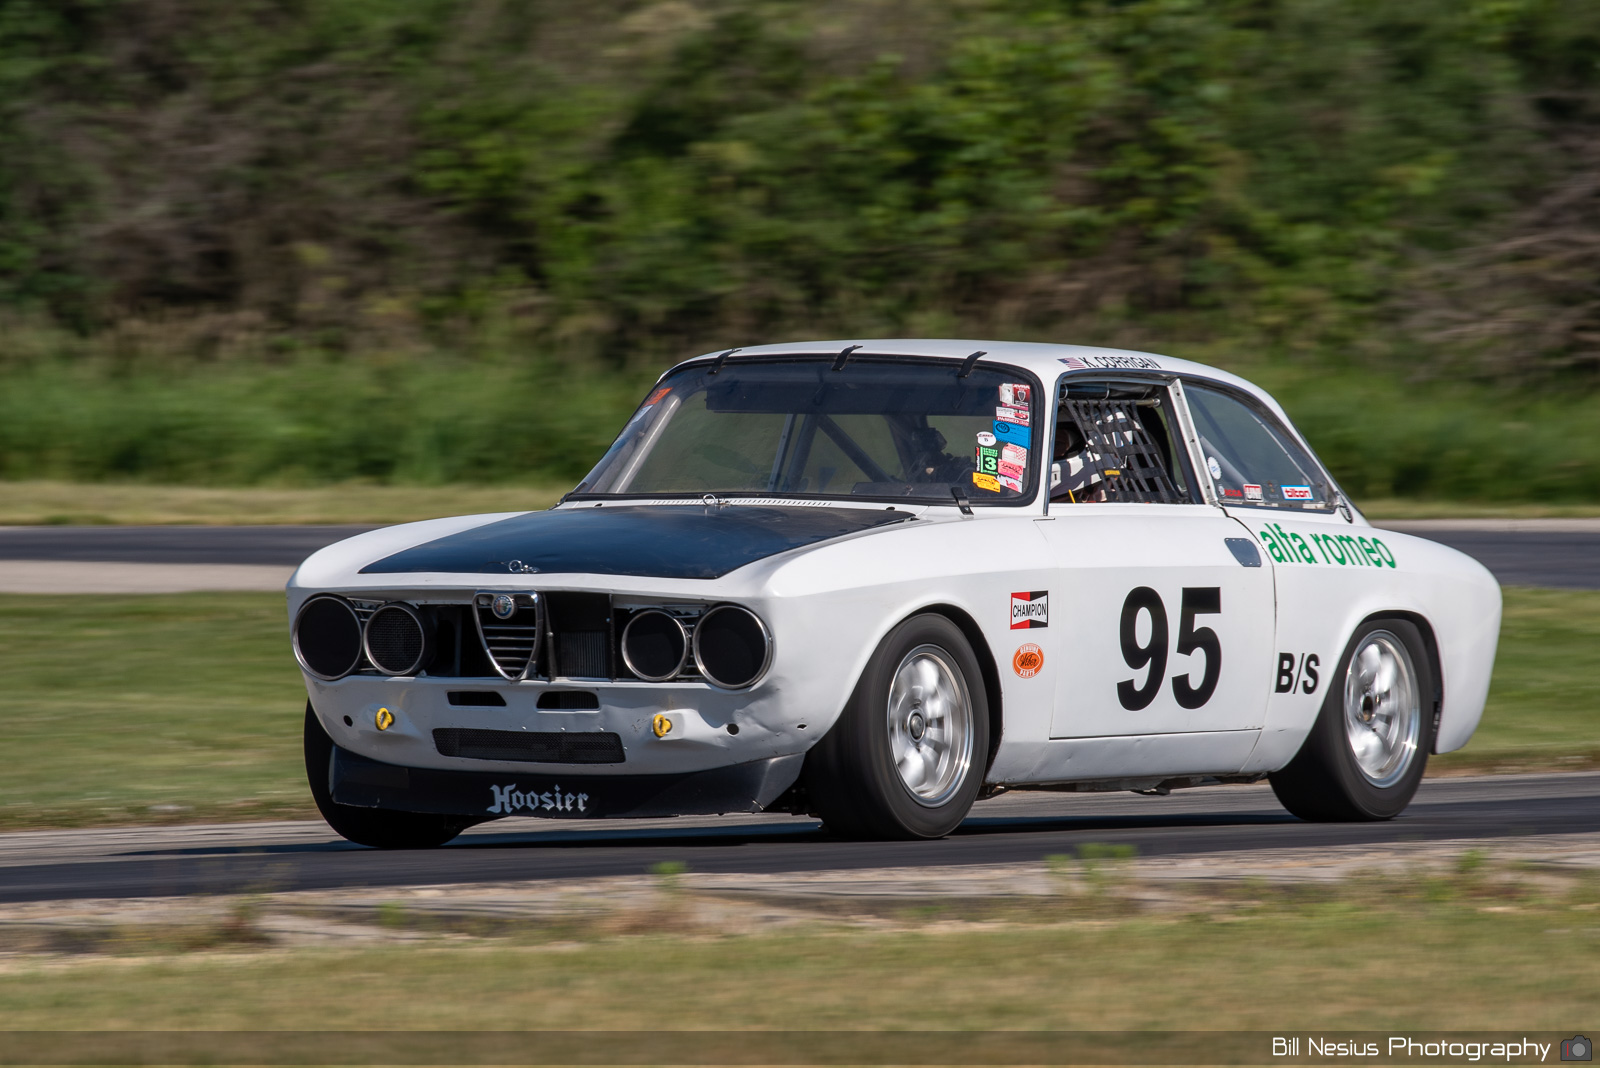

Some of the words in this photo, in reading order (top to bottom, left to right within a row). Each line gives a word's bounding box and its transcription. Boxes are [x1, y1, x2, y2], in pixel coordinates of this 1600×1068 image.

[1094, 356, 1162, 369] CORRIGAN
[984, 456, 997, 471] 3
[1259, 523, 1319, 564] alfa
[1309, 533, 1396, 569] romeo
[1012, 603, 1047, 618] CHAMPION
[1116, 586, 1222, 711] 95
[1274, 652, 1320, 695] B/S
[486, 783, 589, 814] Hoosier
